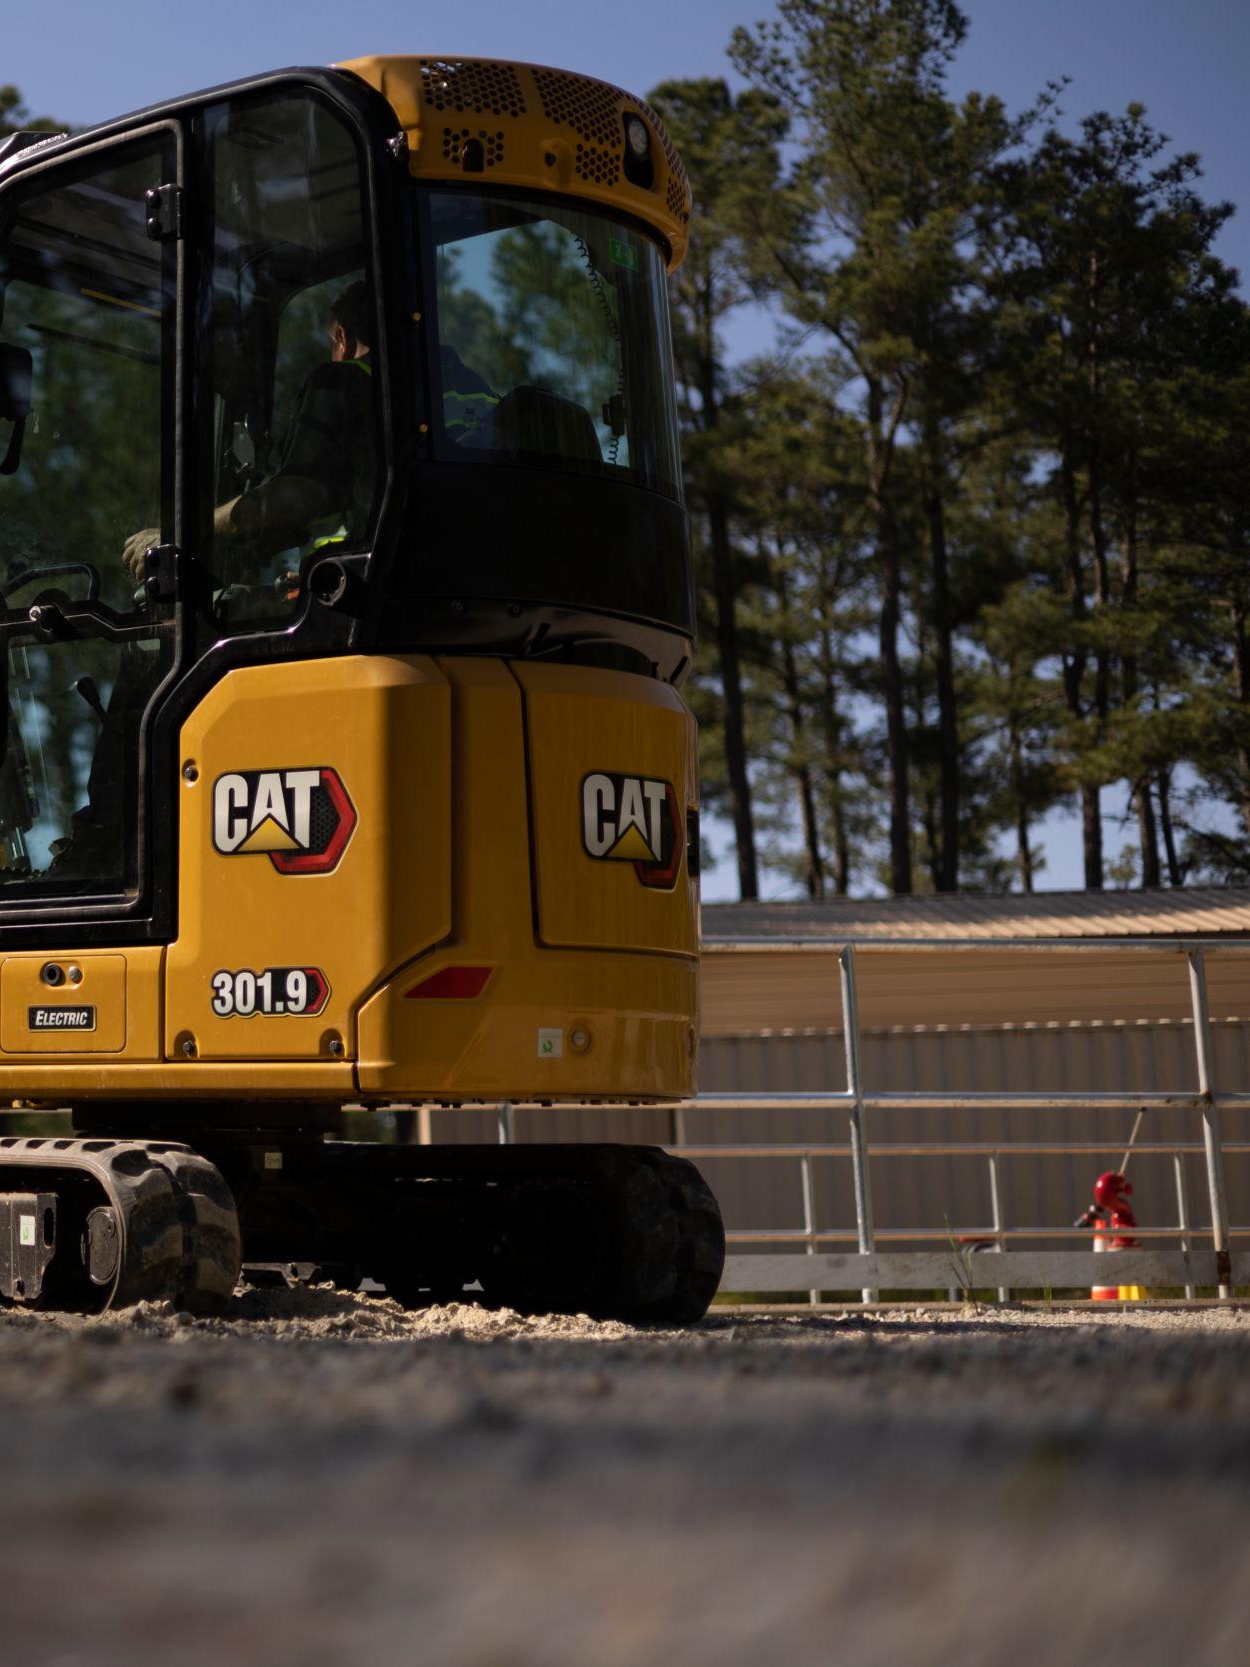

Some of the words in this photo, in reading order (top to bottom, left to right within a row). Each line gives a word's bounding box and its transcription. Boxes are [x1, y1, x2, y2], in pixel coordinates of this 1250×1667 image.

[215, 770, 320, 852] CAT
[583, 774, 666, 861] CAT
[35, 1010, 88, 1026] ELECTRIC
[213, 970, 307, 1014] 301.9
